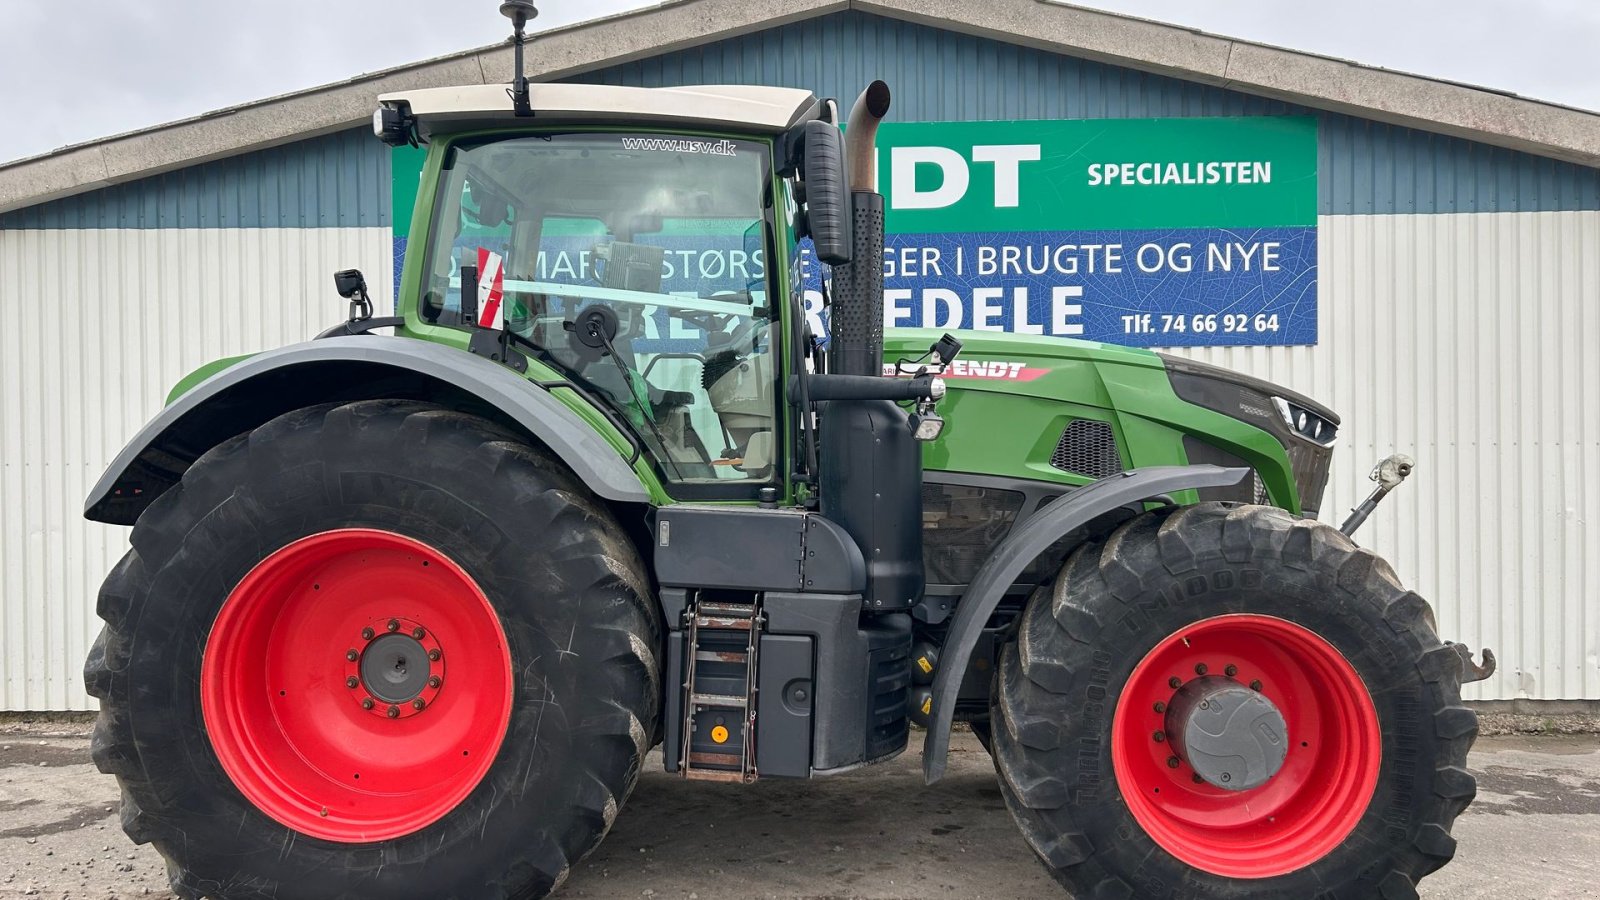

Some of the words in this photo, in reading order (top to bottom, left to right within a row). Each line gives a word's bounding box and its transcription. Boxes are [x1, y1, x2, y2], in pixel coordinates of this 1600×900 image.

[622, 137, 736, 156] www.usv.dk
[1087, 161, 1272, 187] SPECIALISTEN
[956, 247, 963, 275] I
[978, 244, 1122, 275] BRUGTE
[1136, 242, 1192, 273] OG
[1207, 242, 1280, 272] NYE
[1121, 313, 1155, 334] Tlf.
[1161, 314, 1186, 333] 74
[1192, 314, 1217, 332] 66
[1223, 313, 1248, 332] 92
[1254, 313, 1280, 332] 64
[1075, 649, 1112, 809] TRELLEBORG
